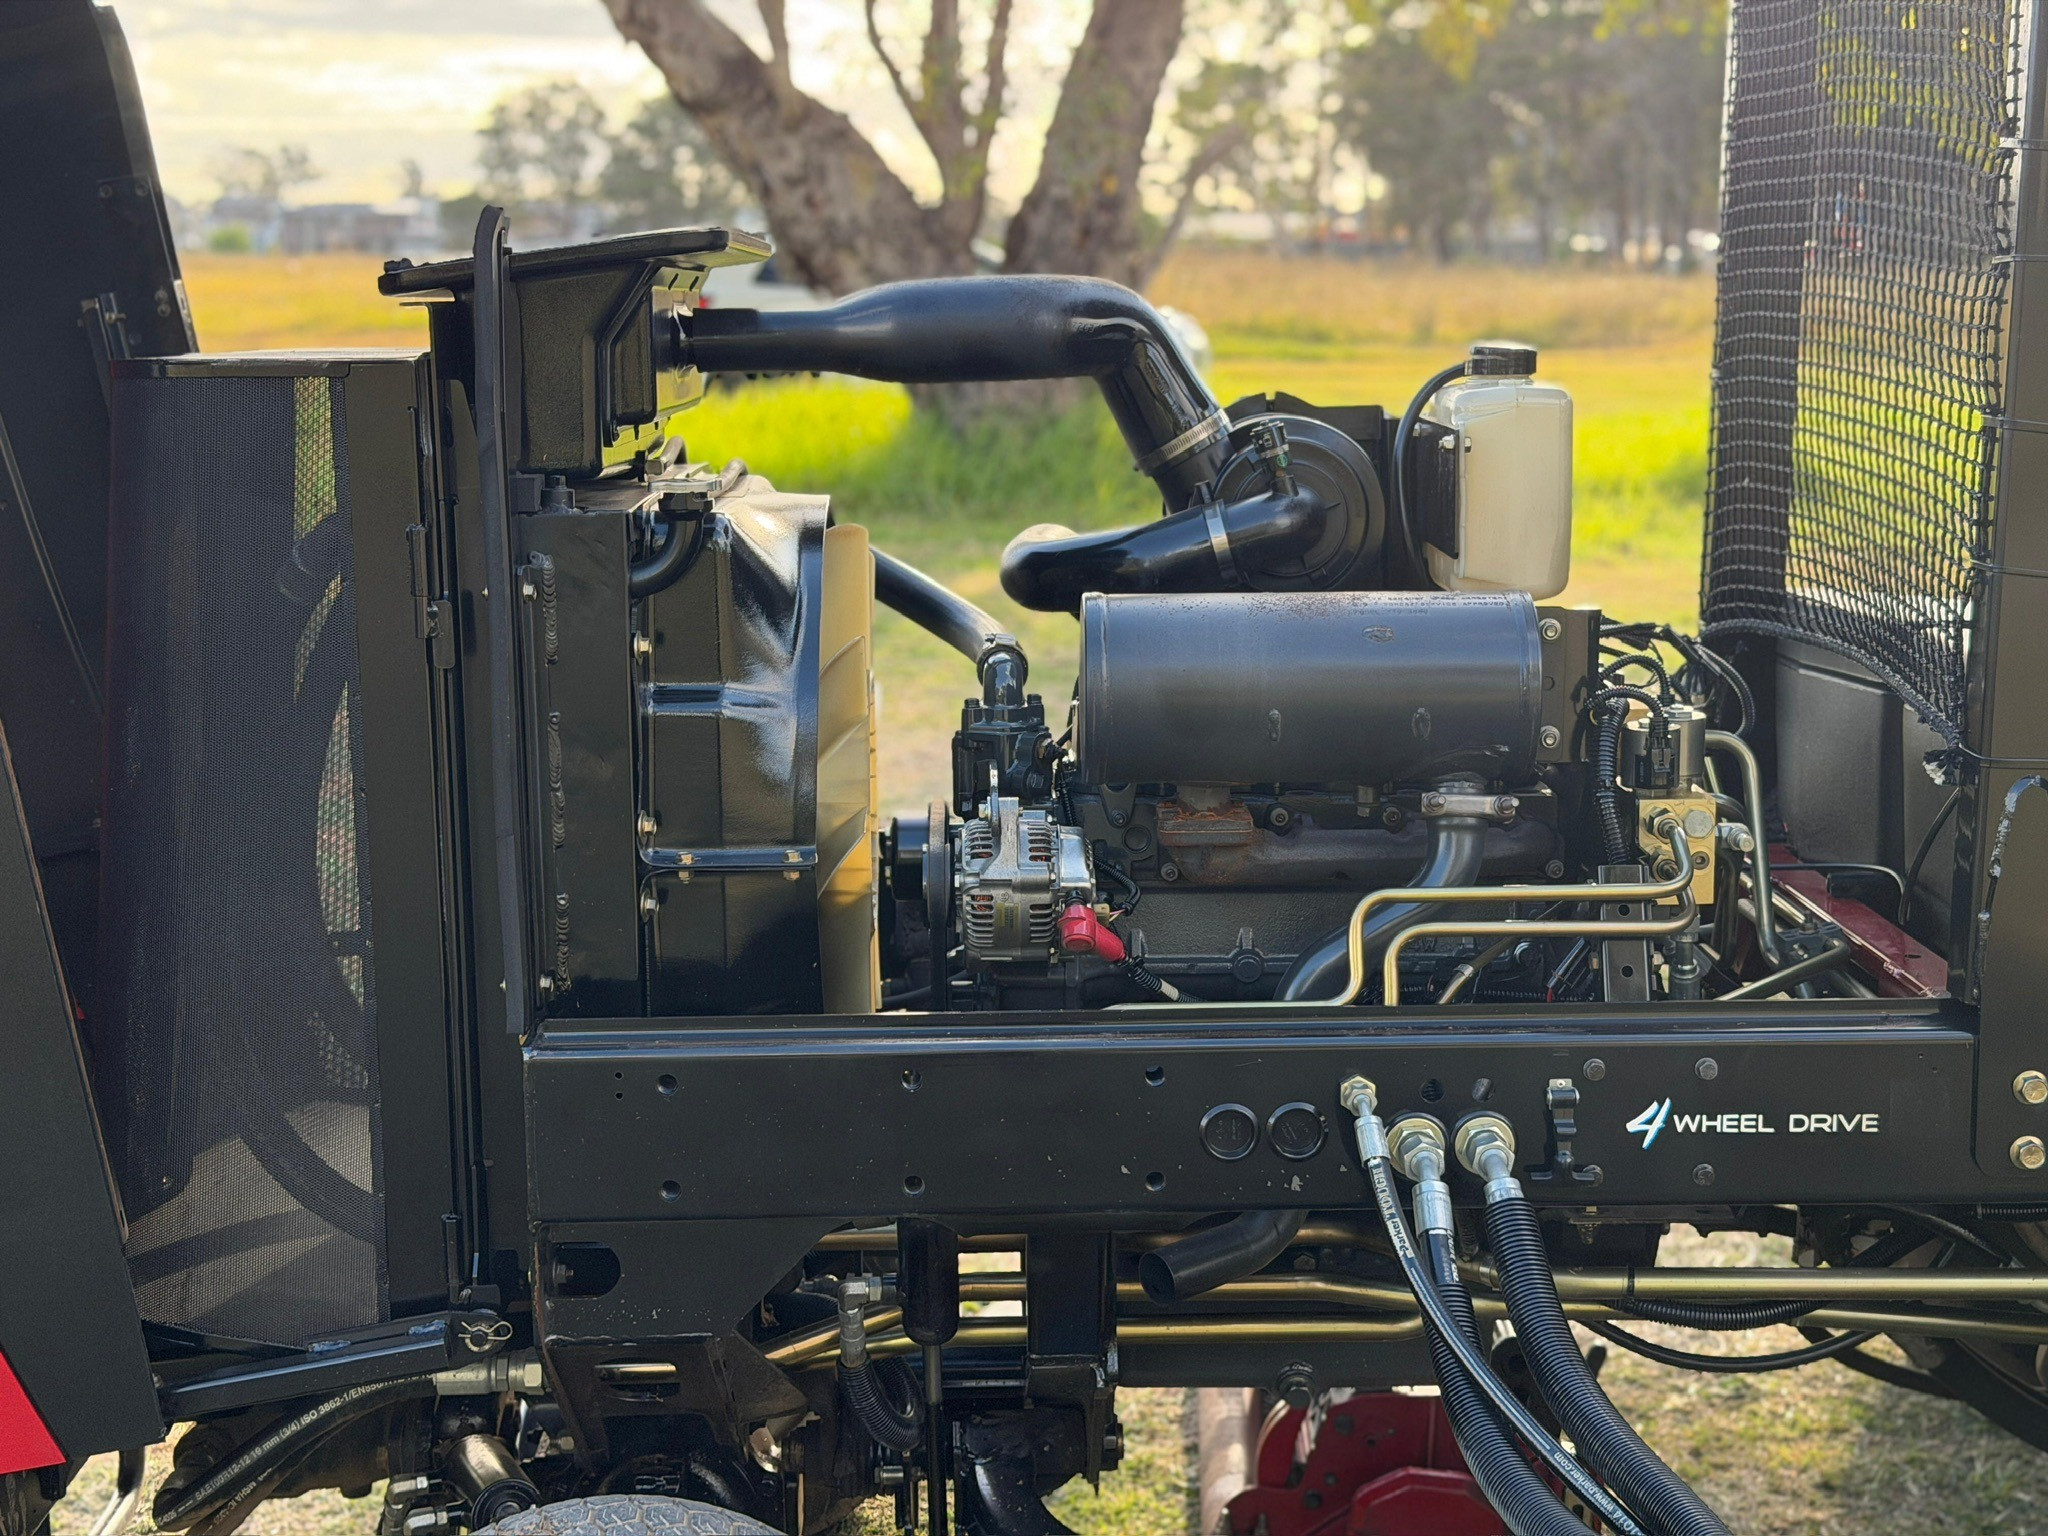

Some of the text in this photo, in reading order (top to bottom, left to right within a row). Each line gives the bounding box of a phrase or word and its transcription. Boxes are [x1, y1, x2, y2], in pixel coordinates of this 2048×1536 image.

[1625, 1097, 1881, 1150] 4 WHEEL DRIVE
[1391, 1219, 1409, 1254] Parker
[194, 1453, 251, 1500] SAE100R12-12
[261, 1435, 281, 1454] mm
[279, 1419, 301, 1440] (3/4)
[300, 1408, 318, 1426] ISO
[1553, 1451, 1616, 1513] www.parker.com
